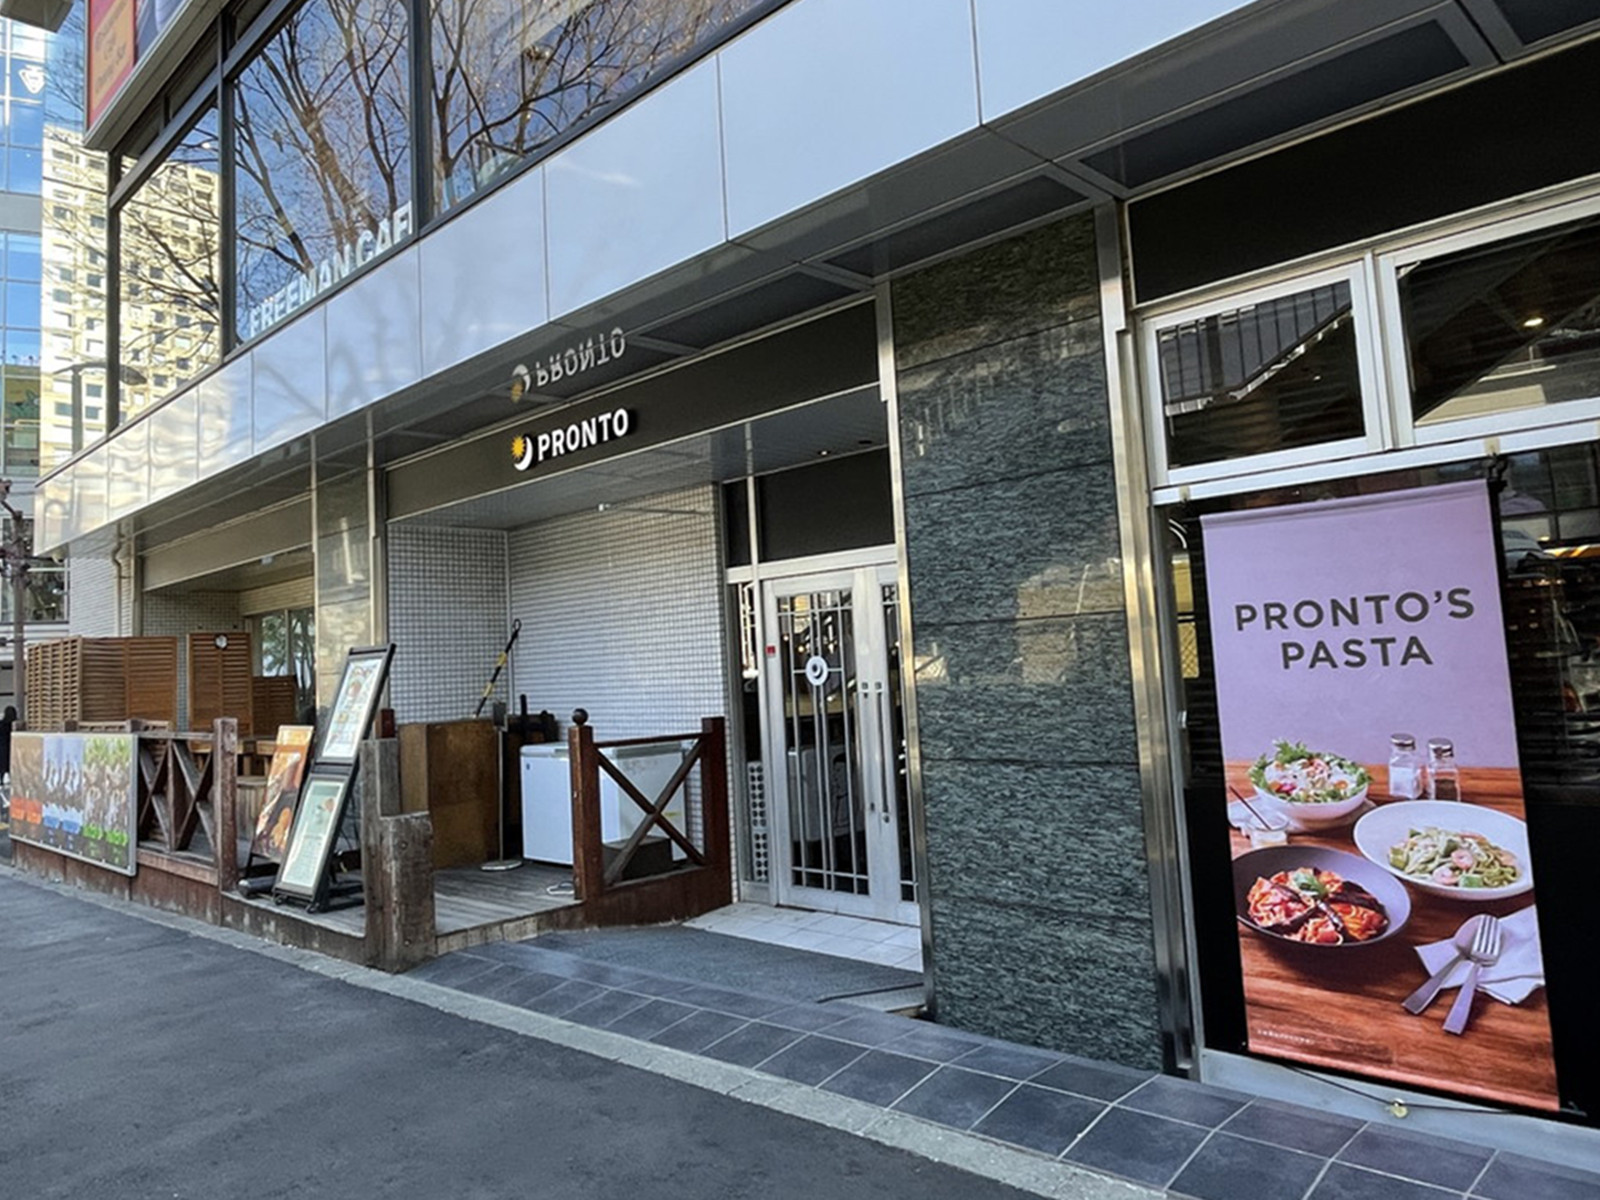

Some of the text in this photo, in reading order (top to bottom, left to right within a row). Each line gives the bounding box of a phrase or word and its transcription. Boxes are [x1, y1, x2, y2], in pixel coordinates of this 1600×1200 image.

[250, 243, 351, 338] FREEMAN
[537, 408, 629, 461] PRONTO
[1281, 636, 1434, 669] PASTA
